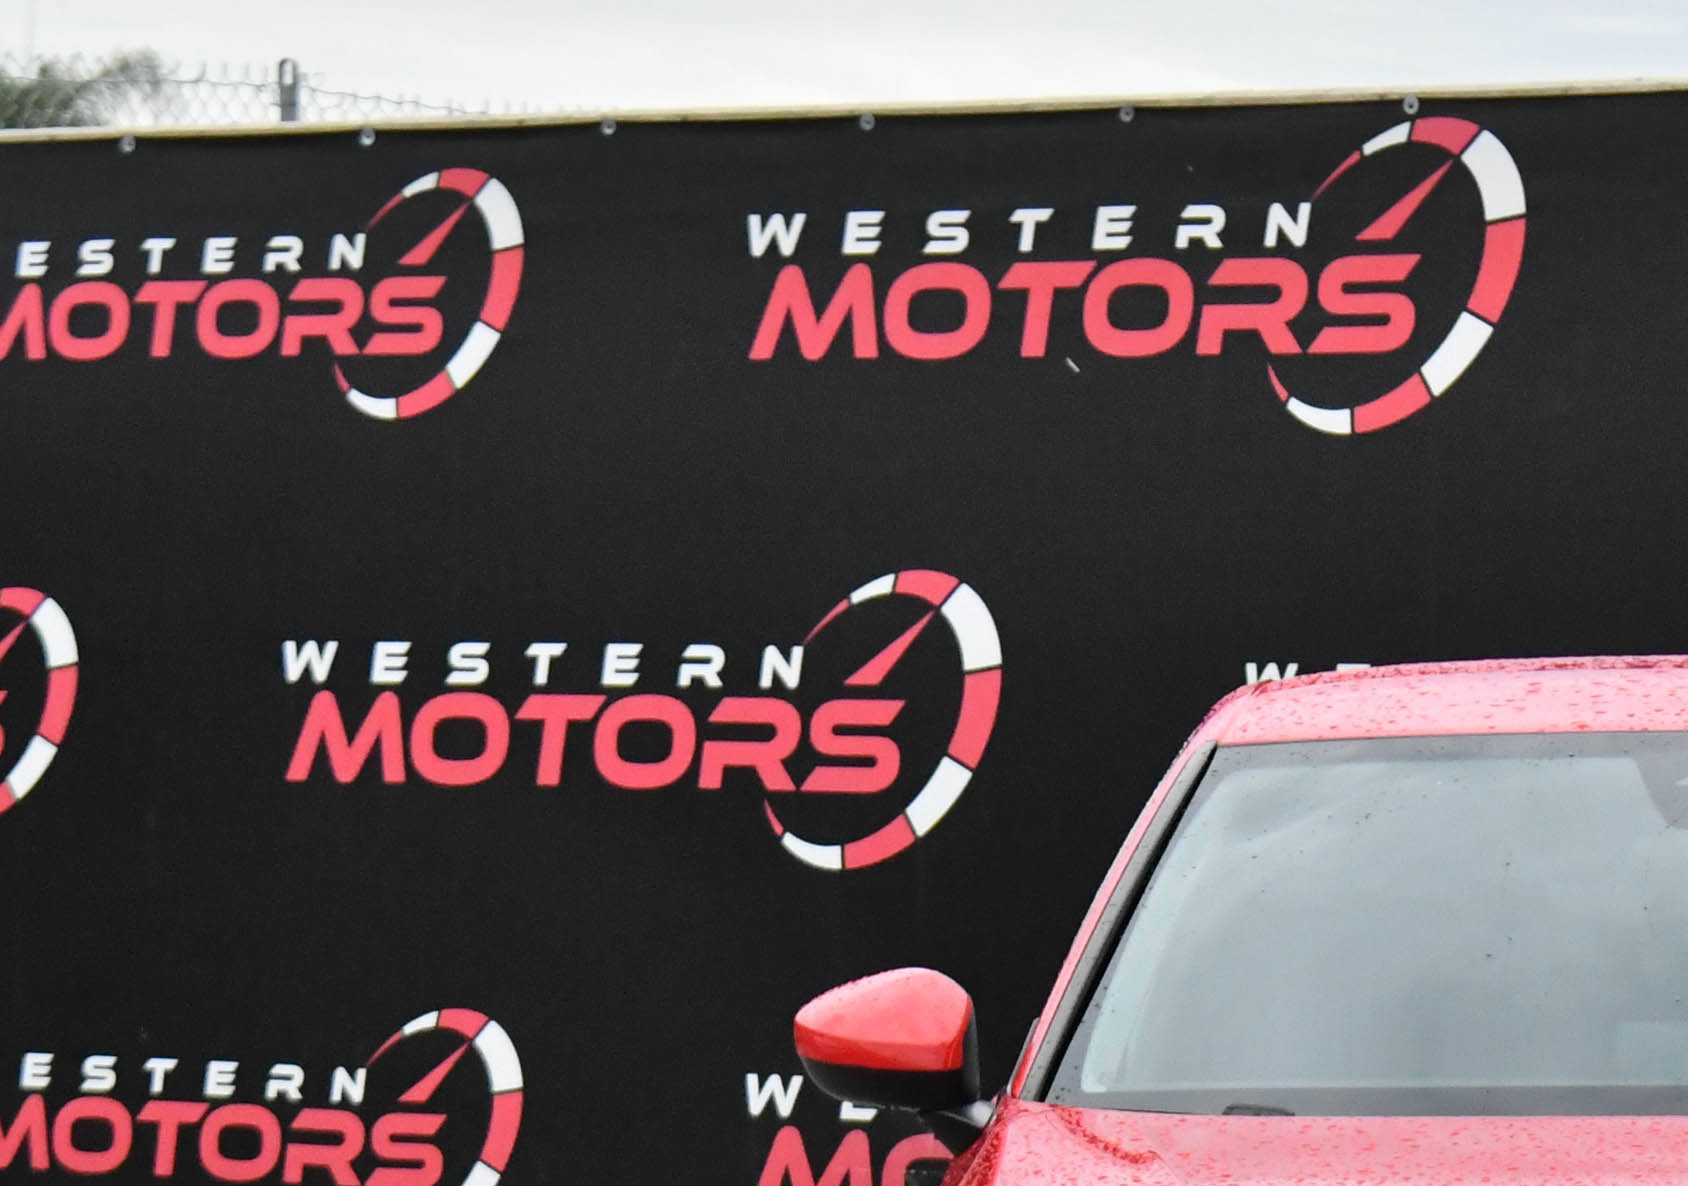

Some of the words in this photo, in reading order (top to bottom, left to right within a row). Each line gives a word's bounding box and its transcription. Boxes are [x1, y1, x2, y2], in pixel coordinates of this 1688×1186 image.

[746, 201, 1312, 258] WESTERN
[748, 253, 1422, 361] MOTORS
[282, 640, 804, 690] WESTERN
[285, 690, 905, 794] MOTORS
